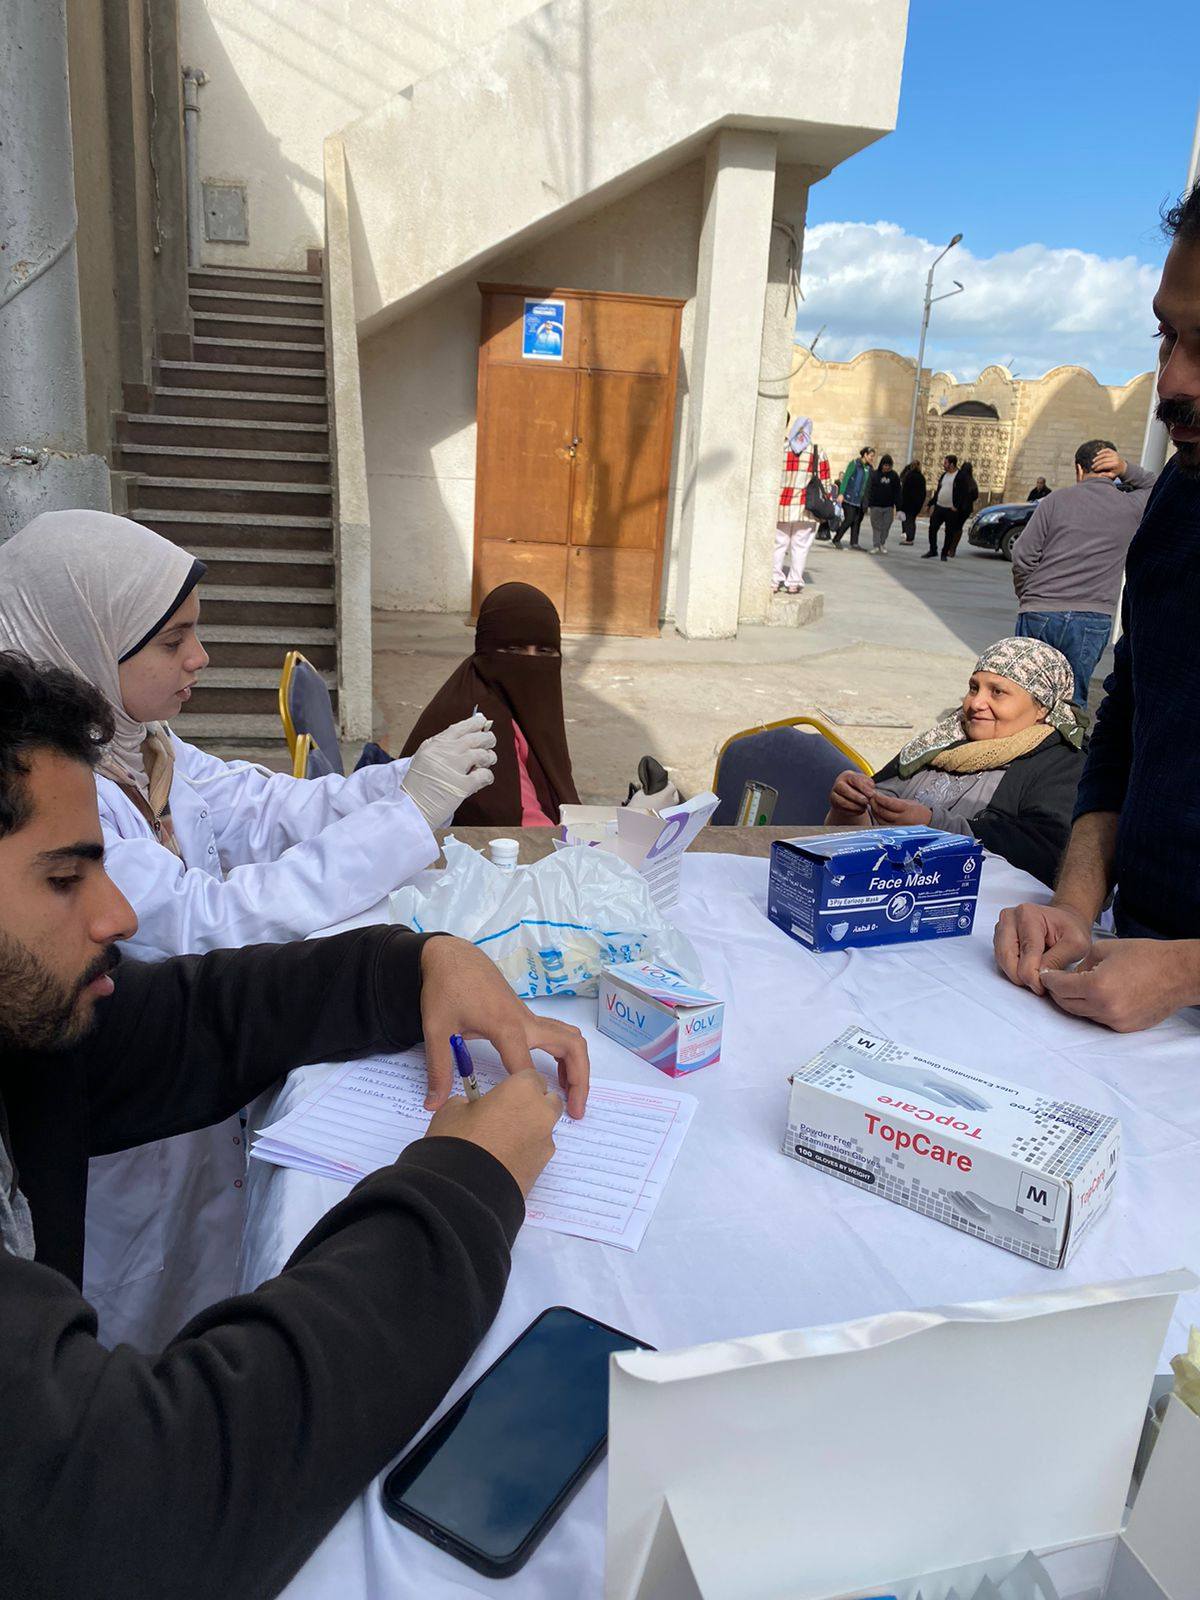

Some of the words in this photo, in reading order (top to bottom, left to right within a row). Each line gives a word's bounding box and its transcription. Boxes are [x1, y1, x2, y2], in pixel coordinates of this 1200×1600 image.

[868, 877, 902, 890] Face
[905, 871, 941, 888] Mask
[641, 965, 688, 988] VOLV
[606, 993, 645, 1029] VOLV
[685, 1014, 715, 1034] VOLV
[857, 1037, 876, 1050] M
[913, 1056, 941, 1069] Gloves
[942, 1065, 994, 1088] Examination
[876, 1095, 982, 1140] TopCare
[800, 1123, 832, 1140] Powder
[833, 1135, 852, 1148] Free
[864, 1113, 973, 1172] TopCare
[799, 1132, 850, 1157] Examination
[852, 1151, 881, 1168] Gloves
[798, 1147, 813, 1158] 100
[815, 1155, 838, 1168] GLOVES
[848, 1168, 870, 1180] WEIGHT
[1027, 1185, 1047, 1206] M
